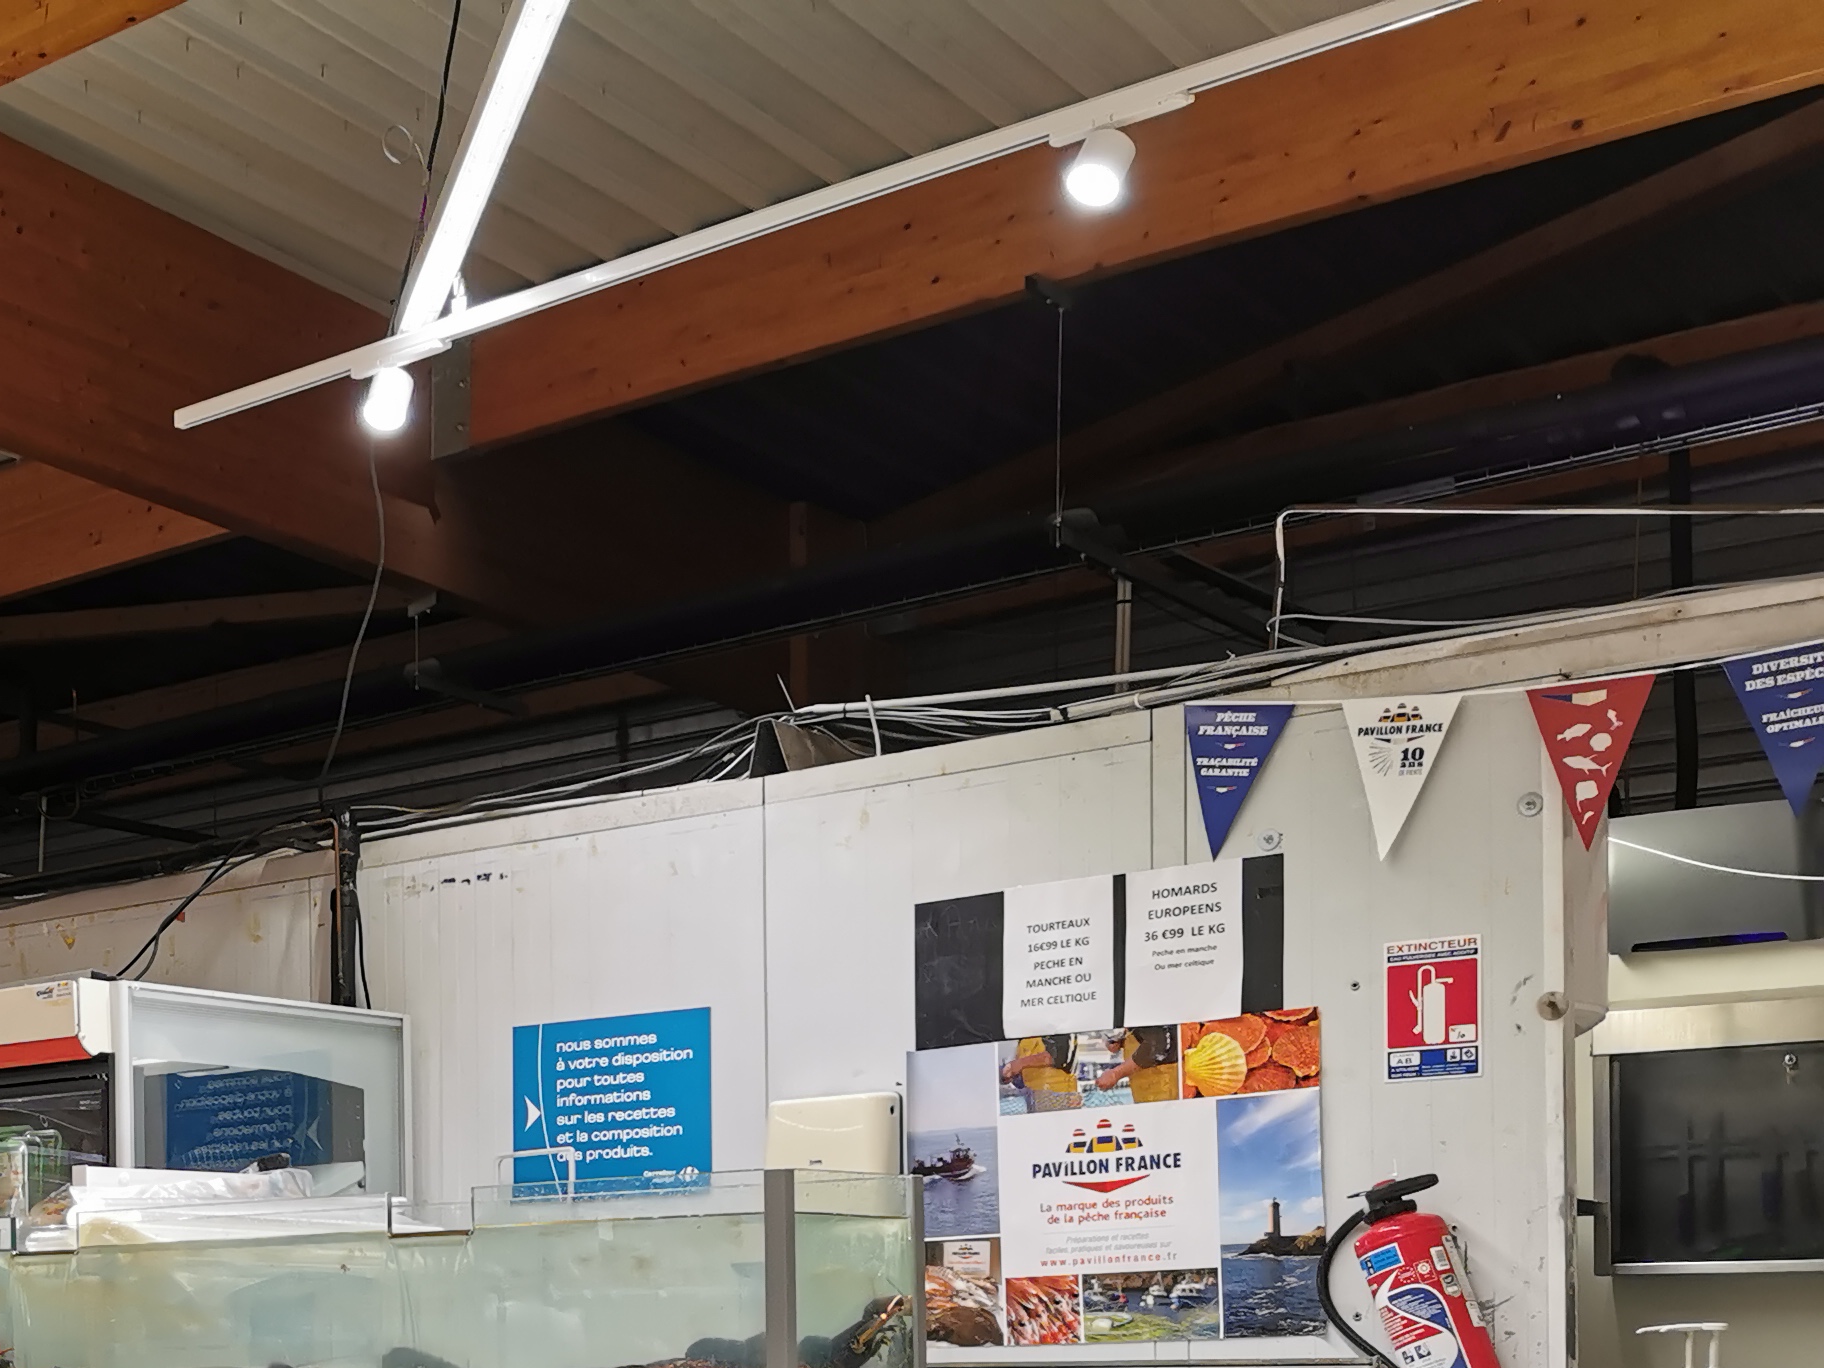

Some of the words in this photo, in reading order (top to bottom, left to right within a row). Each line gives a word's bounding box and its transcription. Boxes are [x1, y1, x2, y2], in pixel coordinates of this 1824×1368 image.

[1744, 676, 1775, 692] DES
[1216, 710, 1256, 722] PÊCHE
[1198, 726, 1269, 738] FRANÇAISE
[1357, 725, 1403, 736] PAVILLON
[1405, 723, 1444, 734] FRANCE
[1401, 747, 1425, 761] 10
[1200, 768, 1250, 776] GARANTIE
[1152, 882, 1218, 899] HOMARDS
[1148, 901, 1222, 920] EUROPEENS
[1027, 917, 1090, 933] TOURTEAUX
[1144, 930, 1158, 942] 36
[1162, 927, 1184, 939] €99
[1191, 925, 1204, 936] LE
[1208, 922, 1226, 934] KG
[1027, 941, 1058, 953] 16€99
[1060, 938, 1071, 948] LE
[1075, 936, 1090, 947] KG
[1187, 944, 1217, 953] manche
[1387, 937, 1478, 955] EXTINCTEUR
[1034, 959, 1066, 970] PECHE
[1069, 956, 1083, 966] EN
[1184, 959, 1214, 967] celtique
[1026, 975, 1072, 988] MANCHE
[1075, 973, 1092, 983] OU
[1020, 998, 1044, 1007] MER
[1047, 991, 1097, 1005] CELTIQUE
[556, 1041, 592, 1053] nous
[593, 1033, 658, 1050] sommes
[556, 1056, 565, 1071] à
[569, 1055, 609, 1070] votre
[611, 1047, 694, 1068] disposition
[556, 1077, 592, 1093] pour
[594, 1070, 645, 1087] toutes
[556, 1088, 651, 1107] informations
[556, 1114, 582, 1126] sur
[584, 1110, 605, 1124] les
[607, 1106, 676, 1122] recettes
[556, 1132, 574, 1144] et
[576, 1130, 589, 1143] la
[591, 1123, 683, 1142] composition
[556, 1149, 583, 1162] ds
[585, 1144, 653, 1164] produits.
[1032, 1157, 1109, 1178] PAVILLON
[1116, 1153, 1182, 1173] FRANCE
[1040, 1203, 1052, 1213] La
[1056, 1201, 1098, 1213] marque
[1102, 1198, 1121, 1209] des
[1125, 1195, 1174, 1210] produits
[1047, 1215, 1060, 1225] de
[1064, 1213, 1074, 1223] la
[1078, 1212, 1110, 1225] pêche
[1114, 1208, 1167, 1221] française
[1040, 1251, 1178, 1267] www.pavillonfrance.fr
